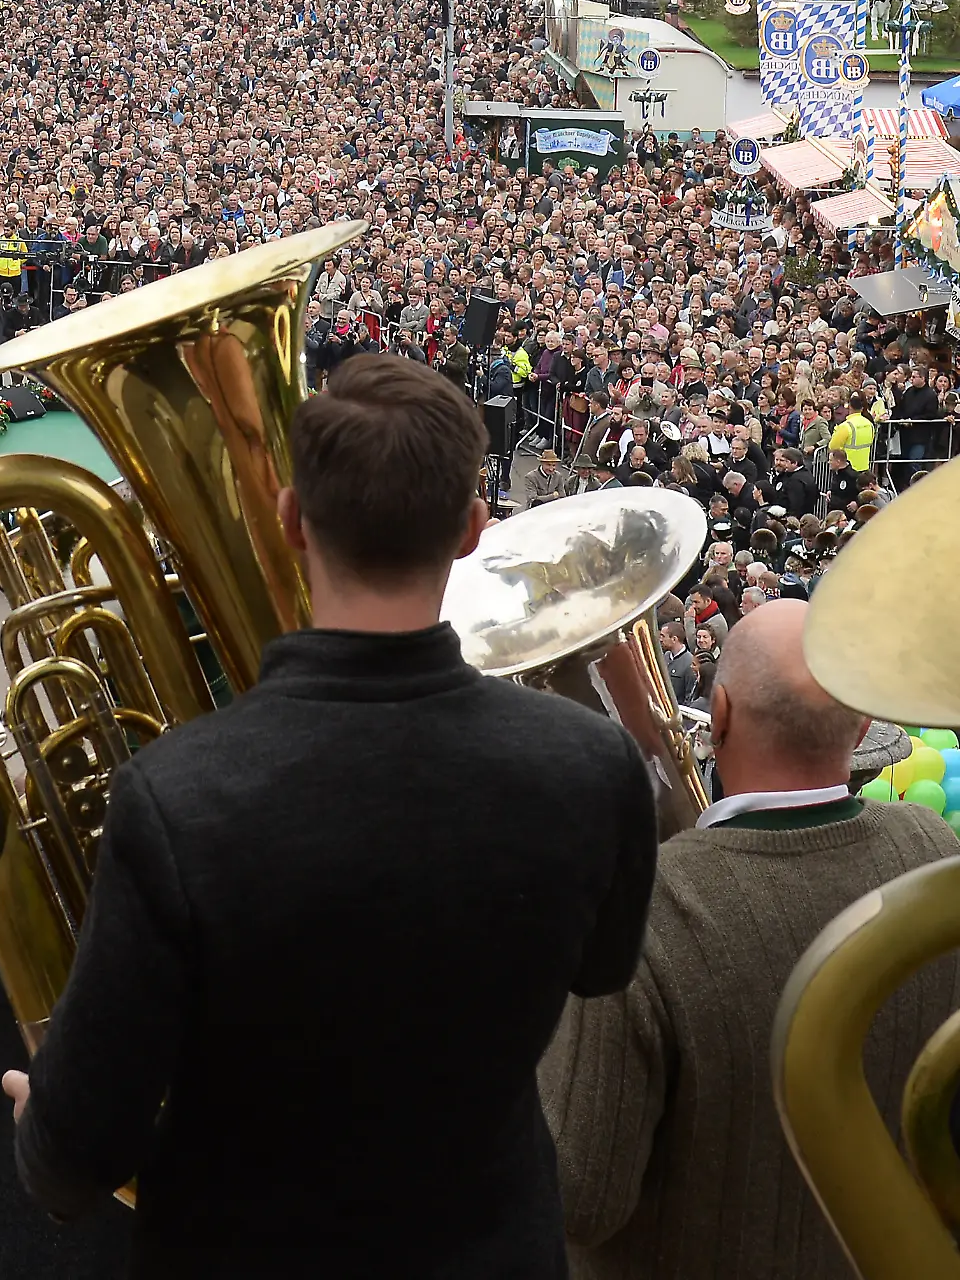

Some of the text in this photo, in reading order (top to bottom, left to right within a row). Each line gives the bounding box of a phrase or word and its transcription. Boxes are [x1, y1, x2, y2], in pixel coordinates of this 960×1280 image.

[643, 60, 655, 70] HB
[847, 66, 862, 79] HB
[739, 151, 753, 163] HB
